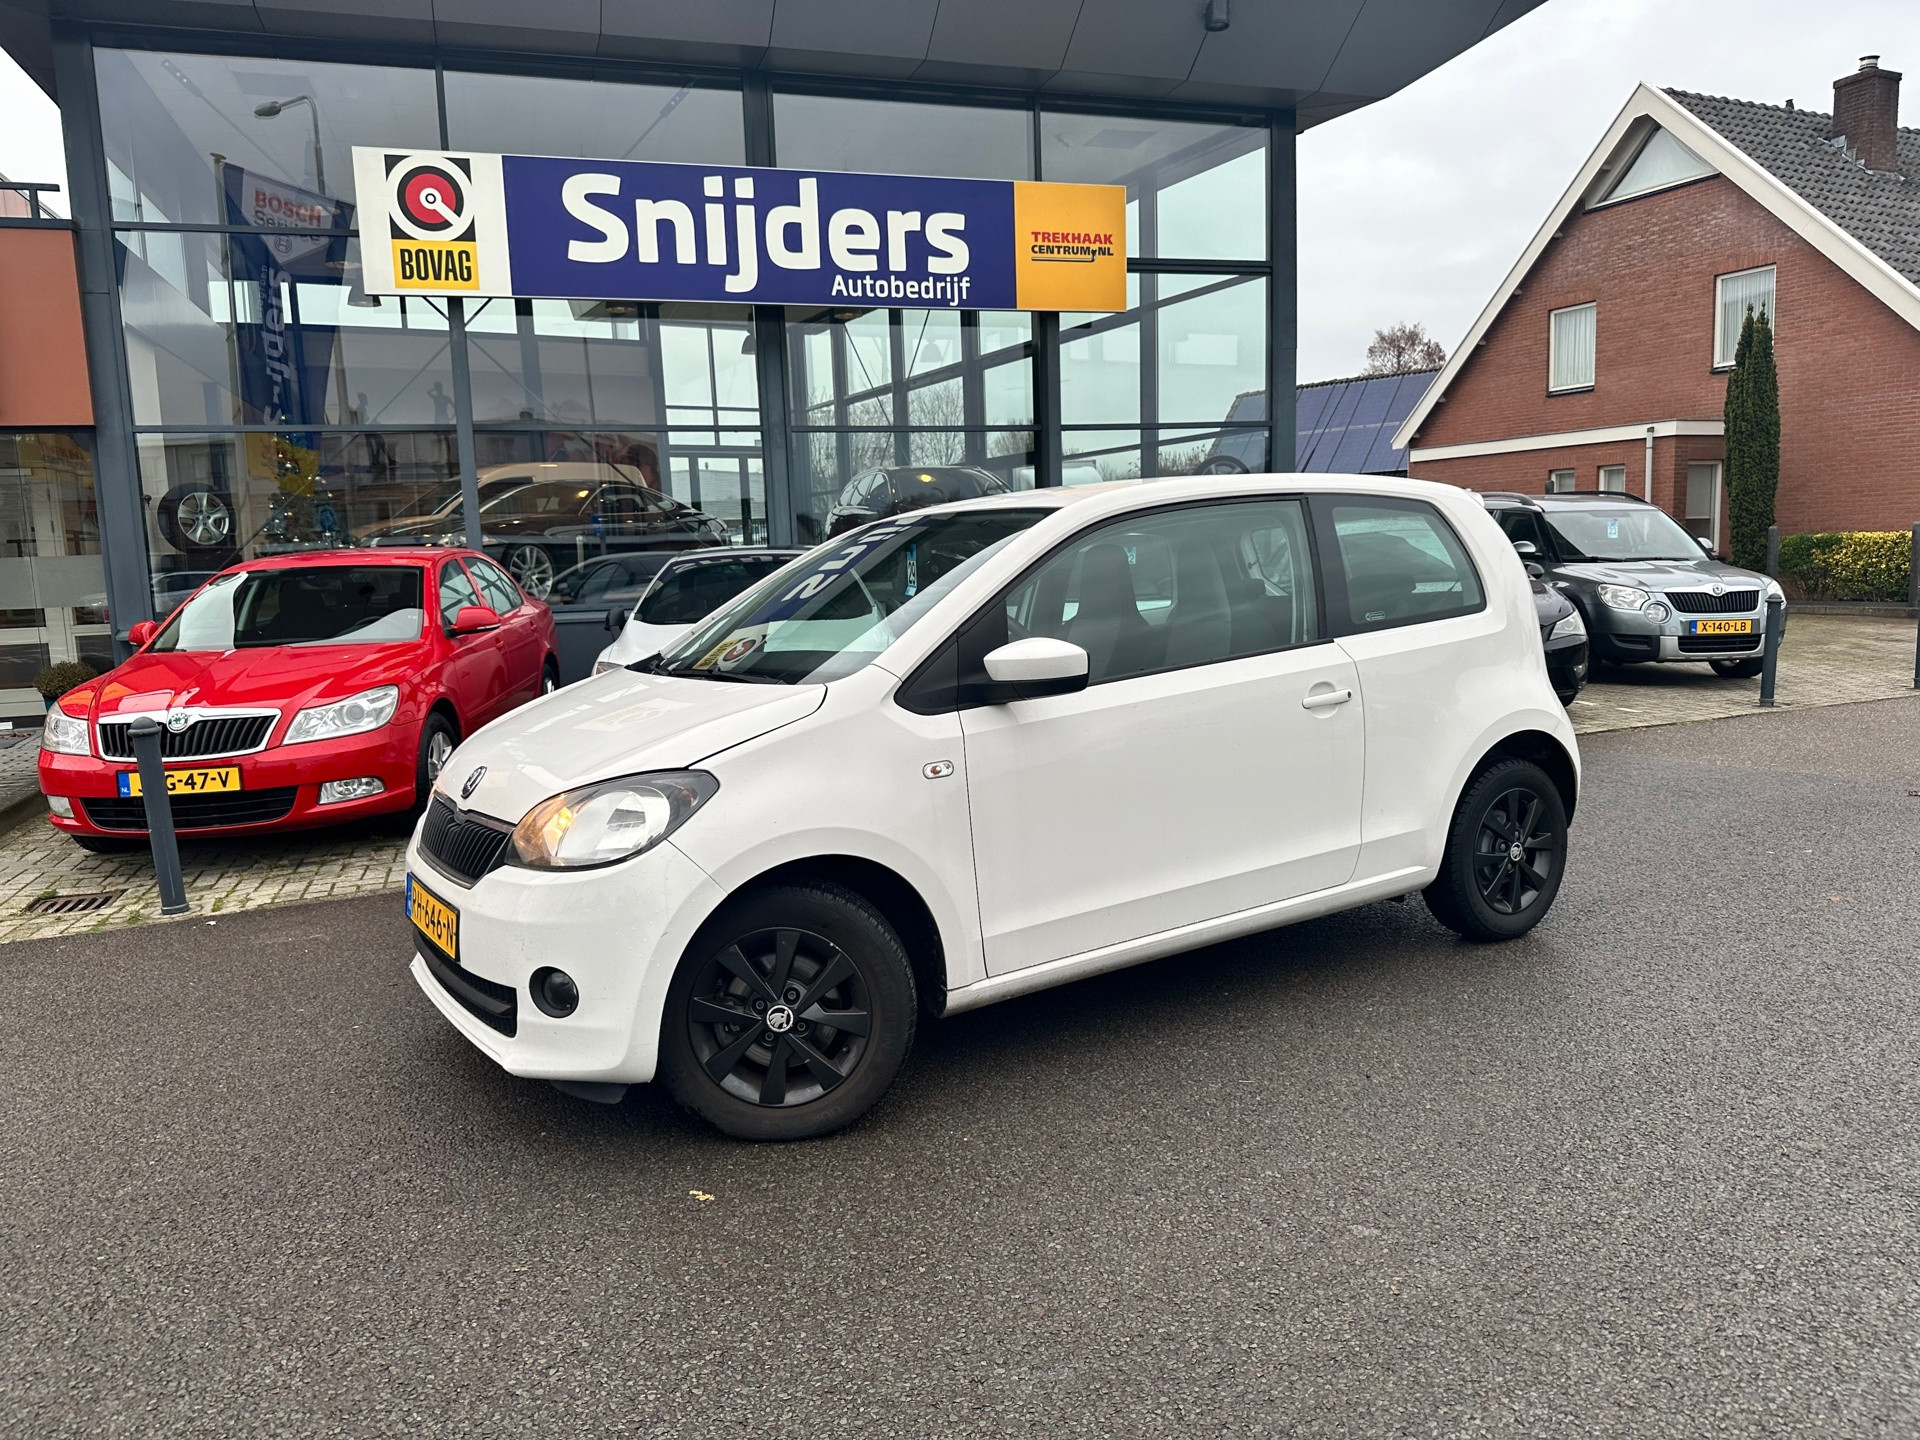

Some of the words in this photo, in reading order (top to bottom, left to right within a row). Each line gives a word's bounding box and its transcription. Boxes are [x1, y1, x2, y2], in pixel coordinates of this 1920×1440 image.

[254, 188, 321, 227] BOSCH
[562, 173, 970, 293] Snijders
[1031, 231, 1113, 245] TREKHAAK
[399, 248, 472, 282] BOVAG
[831, 274, 971, 306] Autobedrijf
[1701, 621, 1747, 632] X-140-LB
[138, 771, 230, 792] G-47-V
[413, 886, 454, 950] RH-646-N
